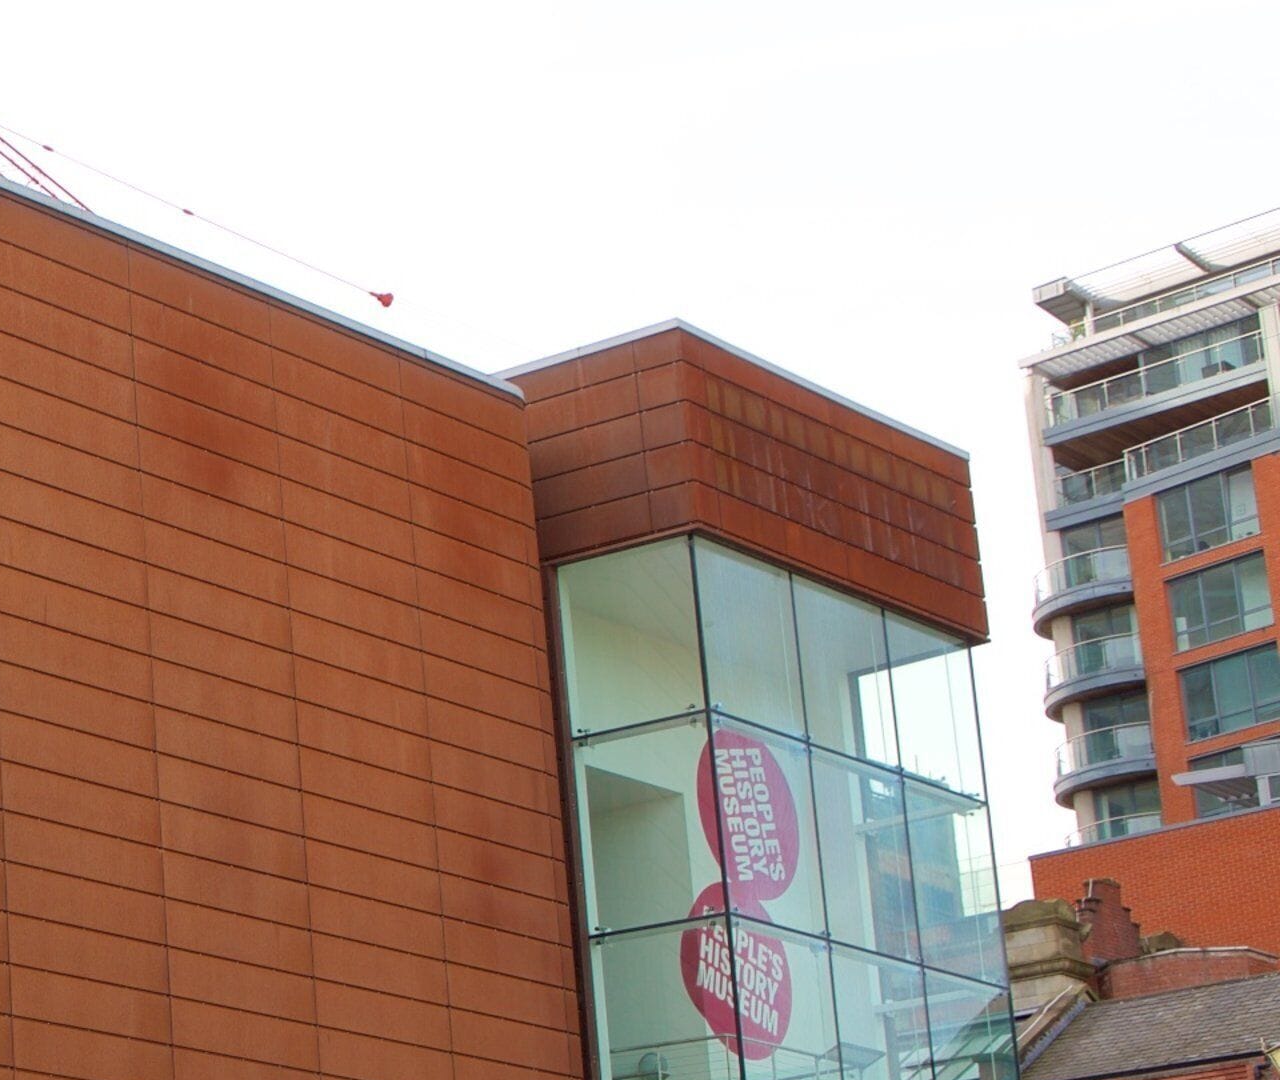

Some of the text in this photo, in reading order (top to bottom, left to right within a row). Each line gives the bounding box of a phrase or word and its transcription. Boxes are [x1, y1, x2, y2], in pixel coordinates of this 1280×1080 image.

[714, 748, 755, 881] MUSEUM
[729, 748, 770, 877] HISTORY
[746, 748, 786, 881] PEOPLE'S
[696, 960, 779, 1036] MUSEUM
[700, 933, 779, 1005] HISTORY
